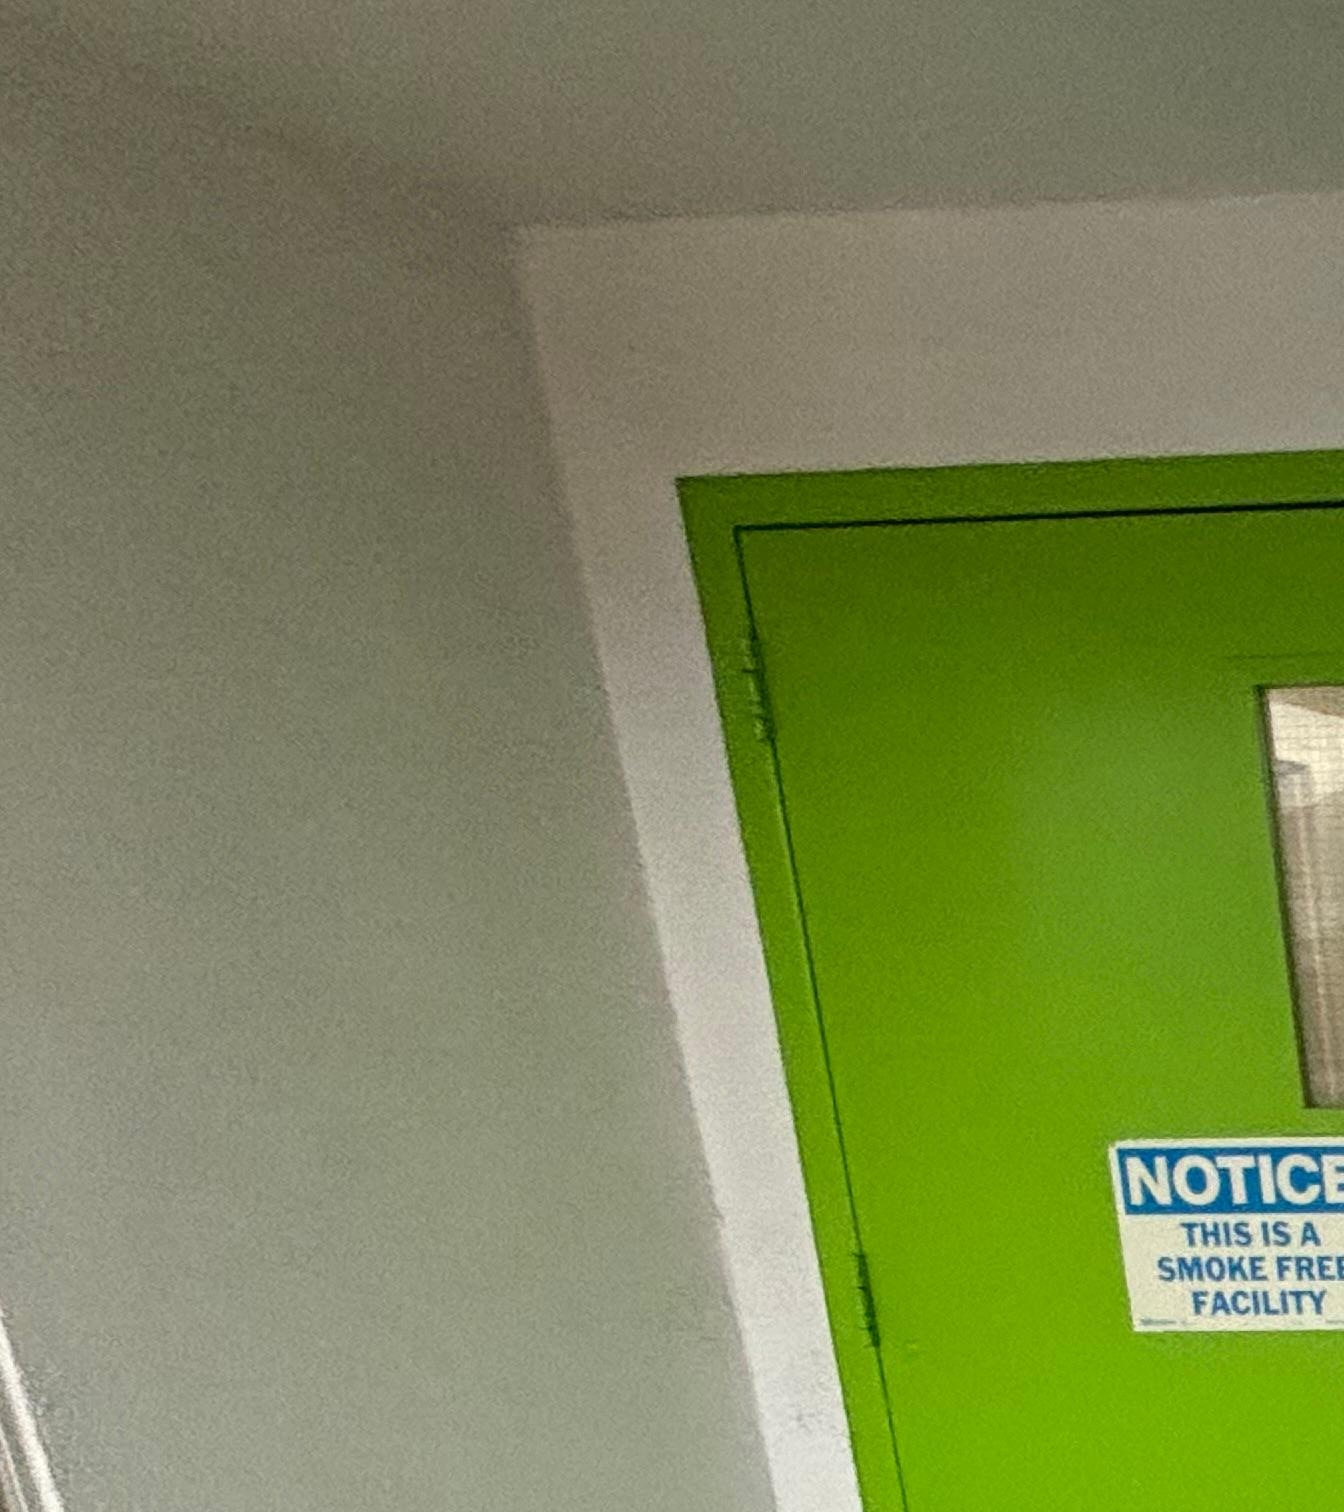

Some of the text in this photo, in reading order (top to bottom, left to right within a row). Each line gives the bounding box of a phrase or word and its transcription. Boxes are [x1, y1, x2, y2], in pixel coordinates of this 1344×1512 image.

[1180, 1221, 1321, 1247] THIS IS A
[1157, 1256, 1268, 1281] SMOKE
[1191, 1290, 1327, 1316] FACILITY
